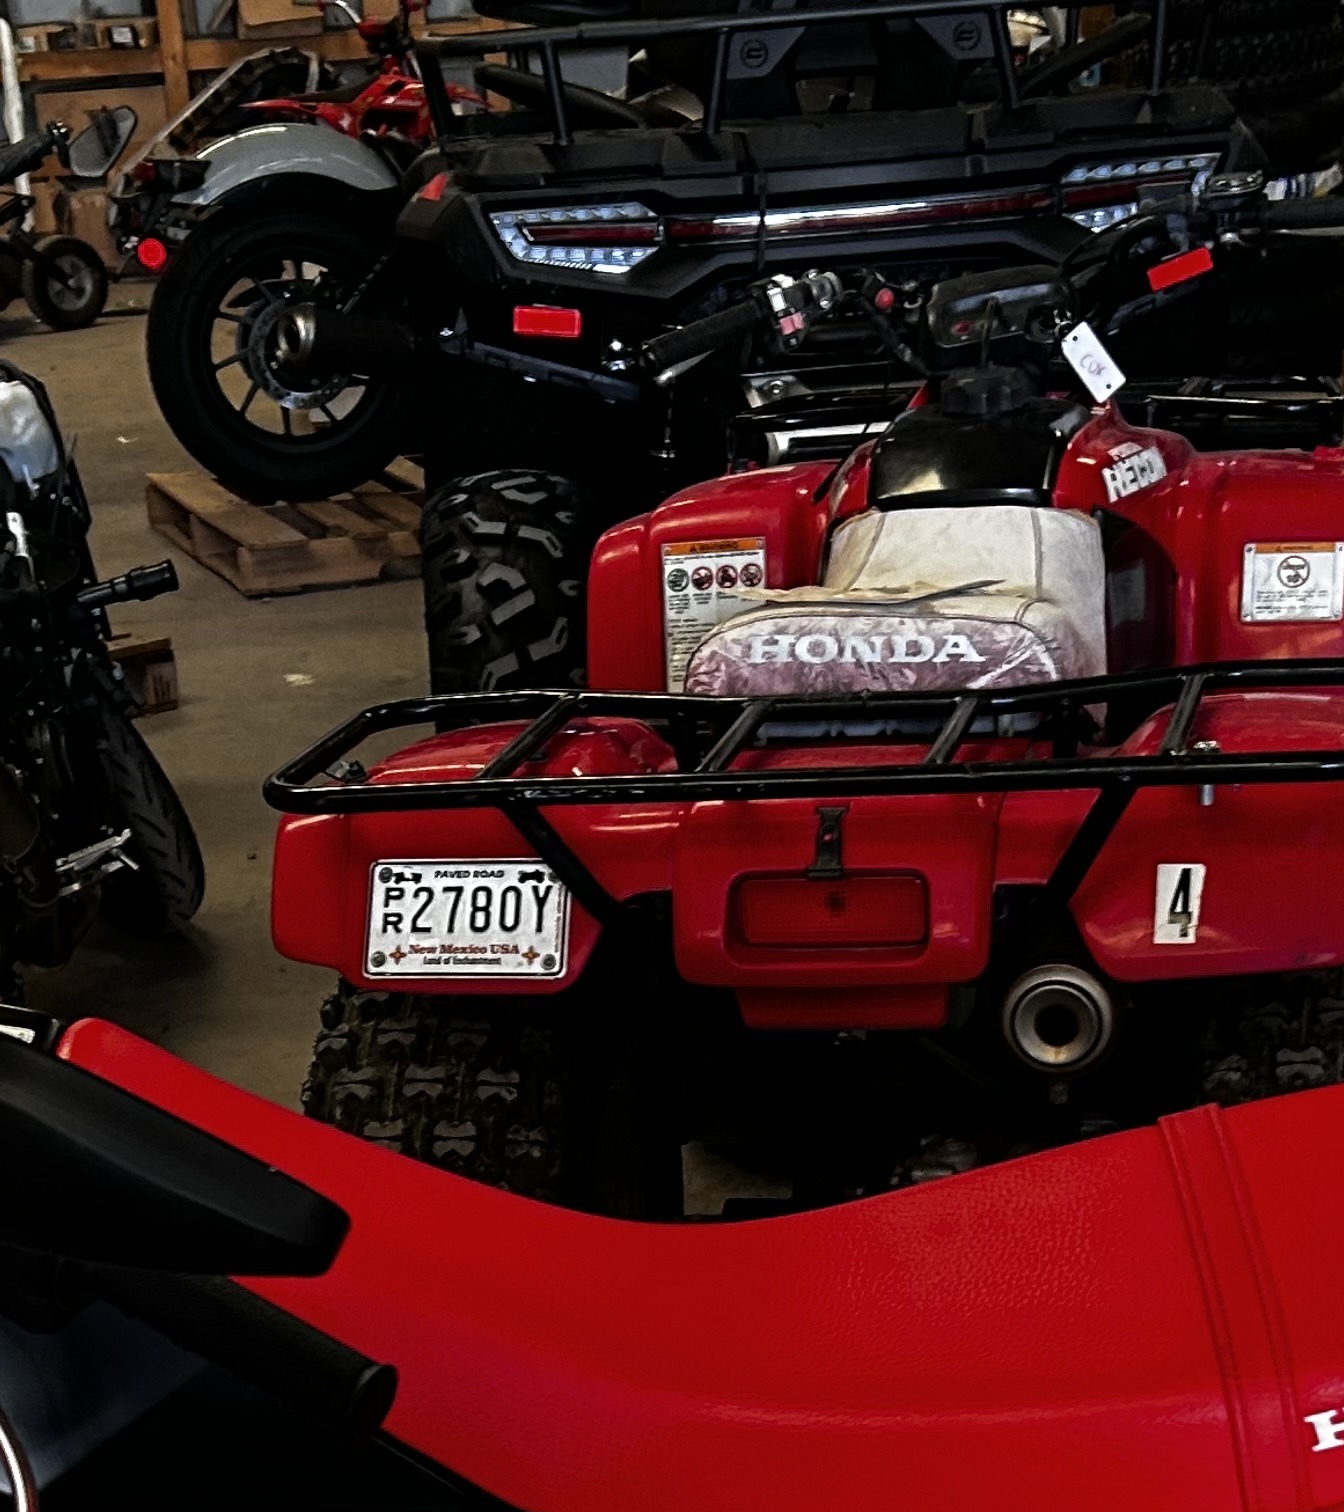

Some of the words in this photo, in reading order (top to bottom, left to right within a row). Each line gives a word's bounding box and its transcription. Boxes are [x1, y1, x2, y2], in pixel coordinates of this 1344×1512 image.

[750, 634, 987, 664] HONDA
[434, 870, 471, 879] PAVED
[473, 870, 505, 879] ROAD
[410, 885, 553, 933] 2780Y
[1167, 867, 1193, 938] 4
[408, 945, 437, 954] New
[439, 944, 487, 955] Mexico
[489, 944, 520, 954] USA
